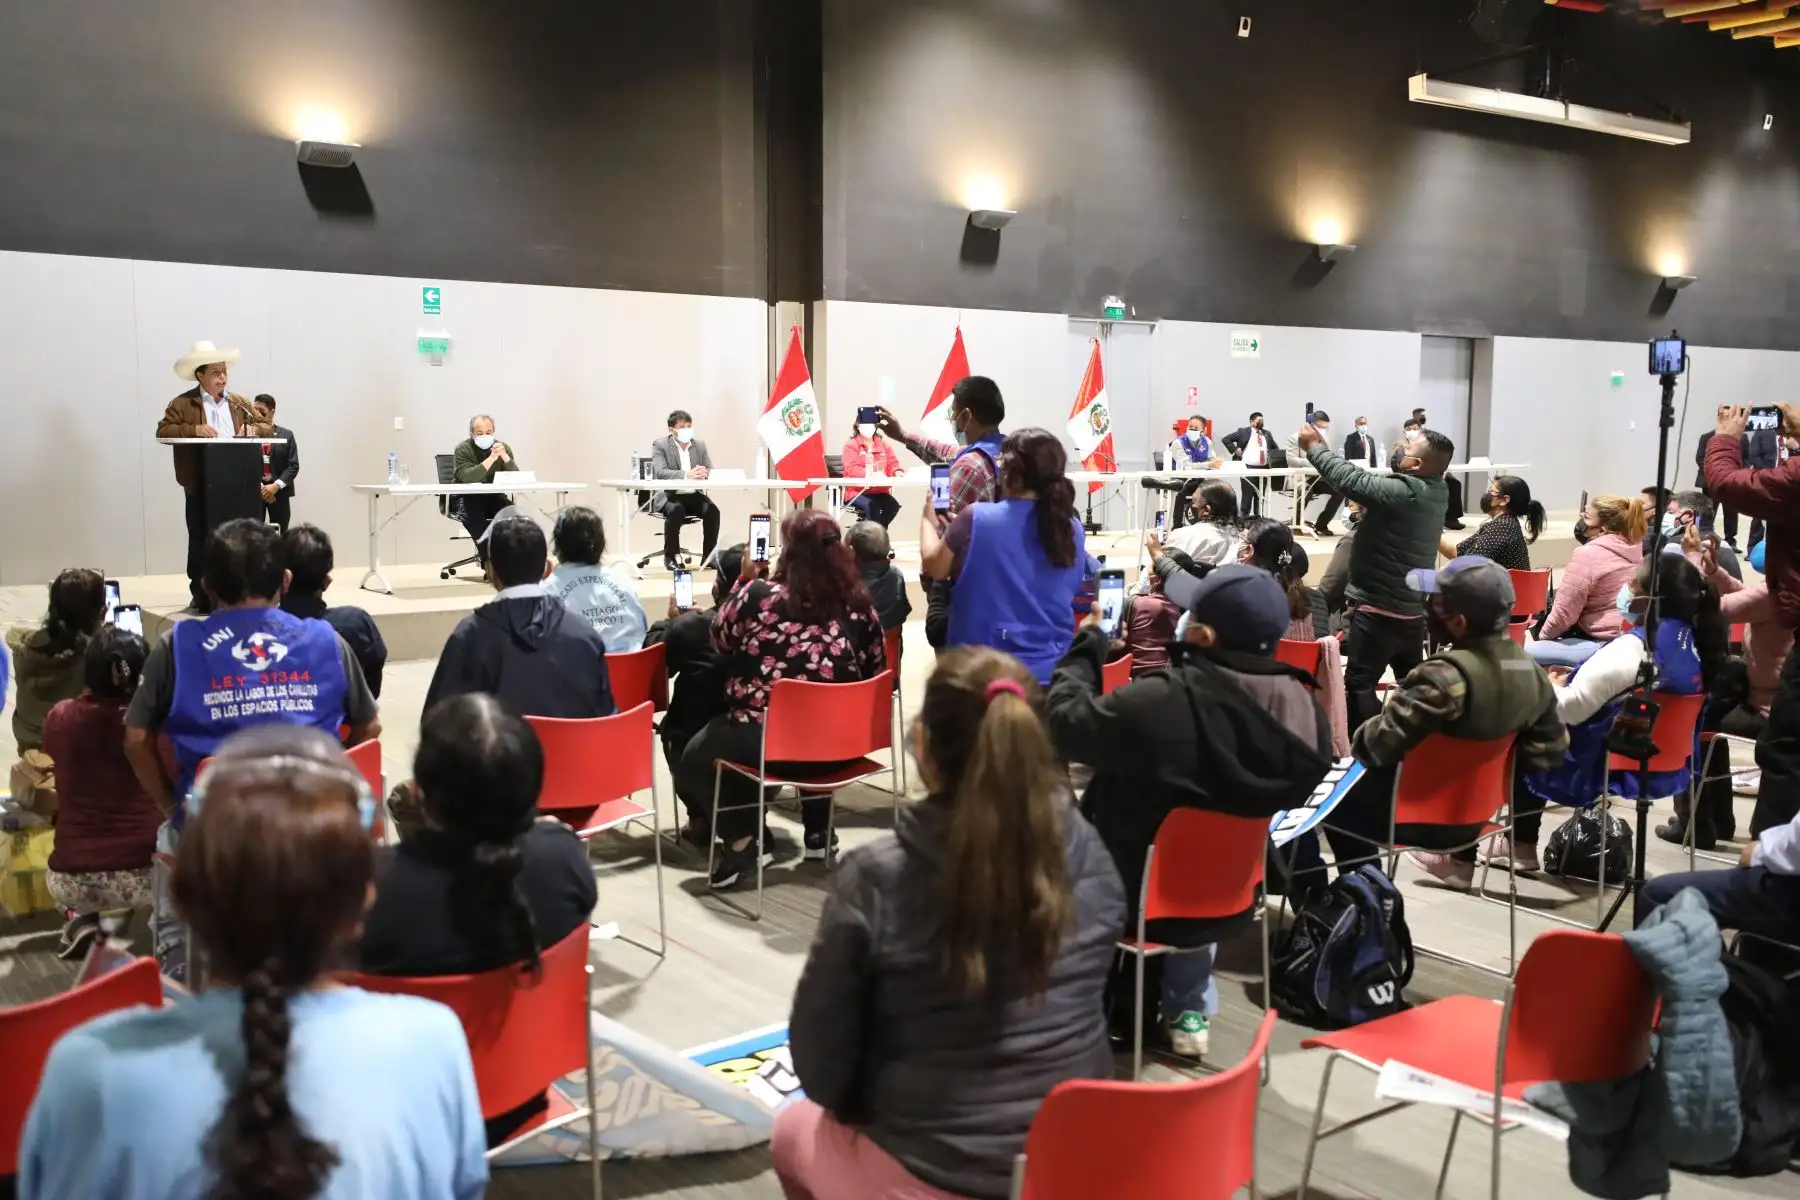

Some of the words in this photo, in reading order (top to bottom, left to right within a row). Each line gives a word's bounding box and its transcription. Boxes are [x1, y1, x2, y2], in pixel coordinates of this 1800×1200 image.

[582, 606, 619, 617] NTIAGO
[202, 626, 235, 651] UNI
[211, 675, 247, 689] LEY
[259, 670, 312, 684] 31344
[235, 689, 245, 701] LA
[245, 687, 266, 700] LABOR
[266, 685, 275, 698] DE
[275, 684, 288, 697] LOS
[211, 707, 222, 720] EN
[223, 705, 239, 718] LOS
[241, 700, 279, 715] ESPACIOS
